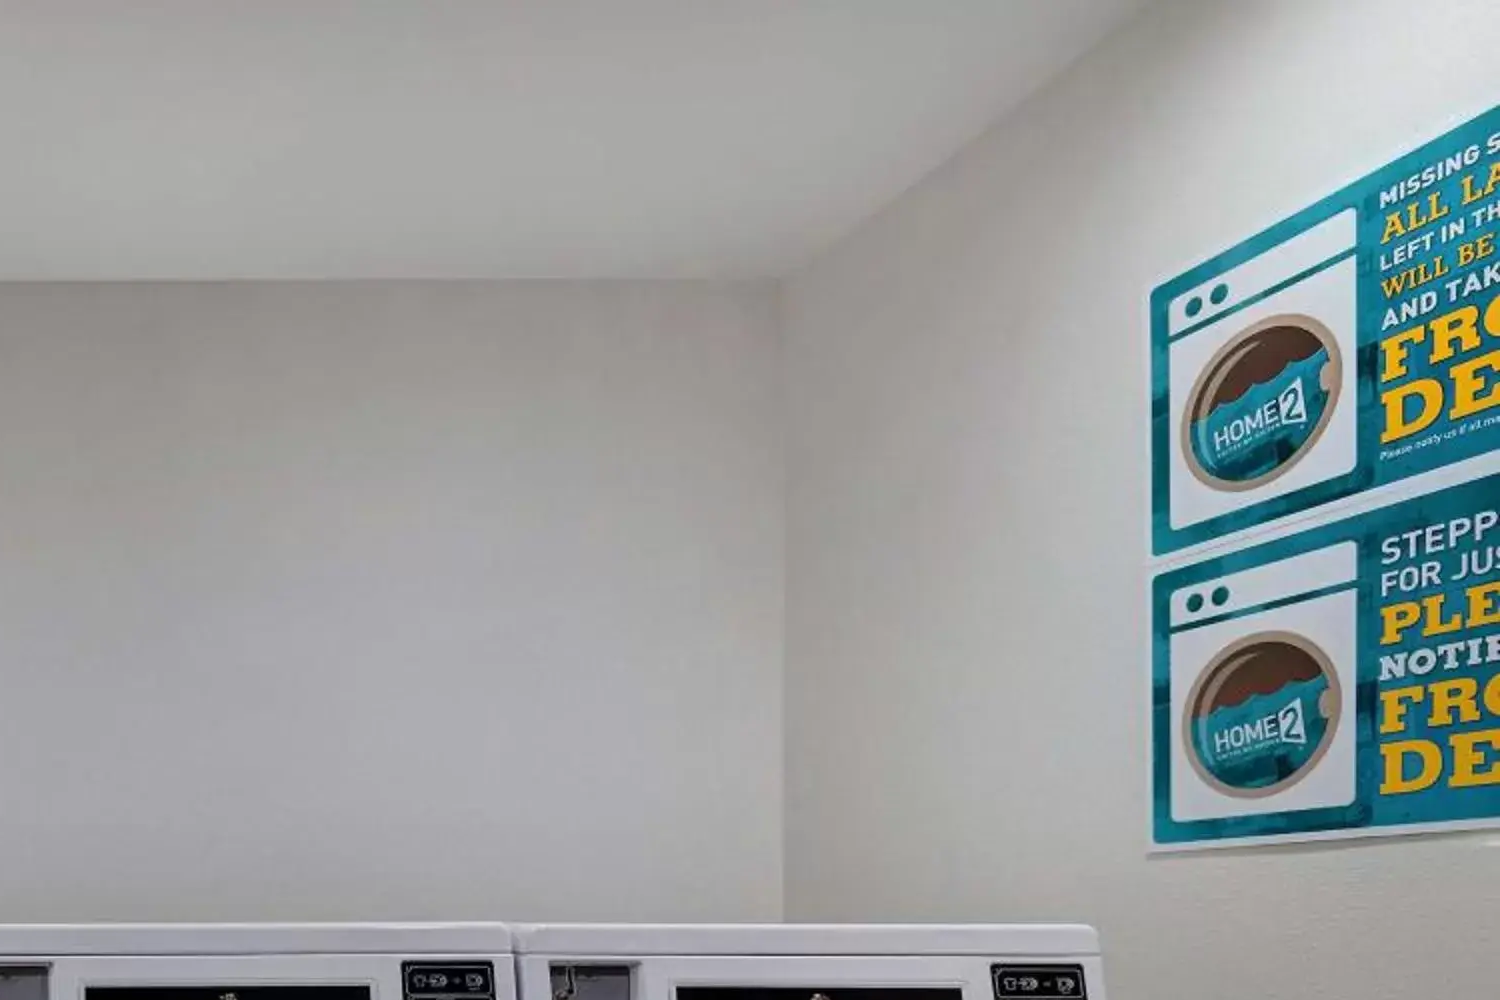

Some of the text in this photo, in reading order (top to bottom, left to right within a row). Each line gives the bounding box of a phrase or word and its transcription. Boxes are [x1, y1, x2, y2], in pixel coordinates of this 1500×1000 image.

[1379, 144, 1480, 210] MISSING
[1380, 191, 1450, 244] ALL
[1380, 231, 1434, 271] LEFT
[1441, 217, 1465, 243] IN
[1381, 232, 1494, 298] WILL BE
[1381, 291, 1438, 331] AND
[1380, 350, 1500, 444] DE
[1381, 510, 1498, 565] STEPP
[1381, 546, 1500, 597] FOR JU
[1380, 729, 1500, 795] DE
